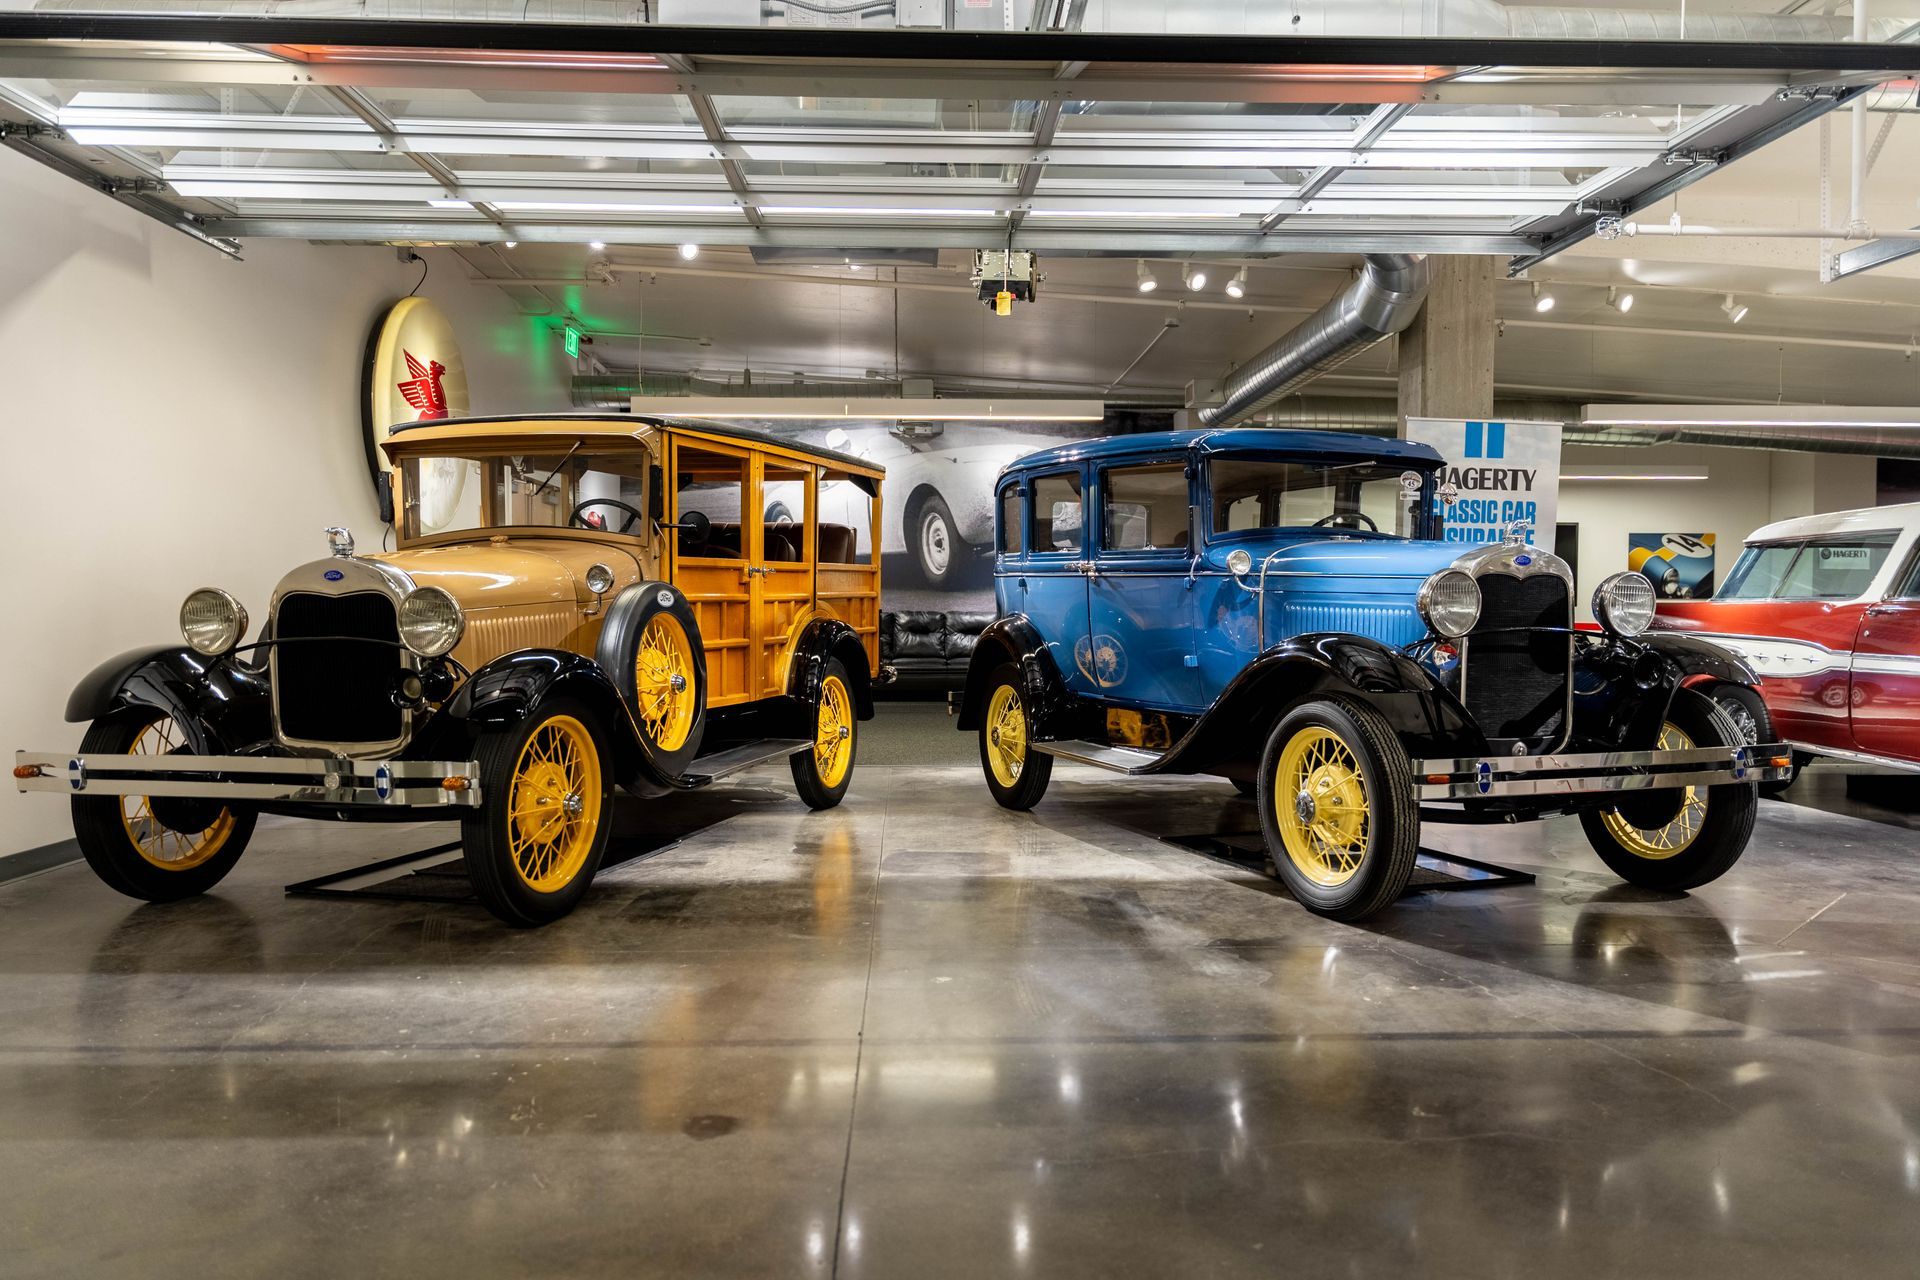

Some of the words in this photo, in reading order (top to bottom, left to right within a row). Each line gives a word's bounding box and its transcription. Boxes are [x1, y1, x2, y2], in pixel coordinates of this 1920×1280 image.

[1502, 500, 1536, 525] CAR
[1666, 535, 1706, 553] 14
[1833, 550, 1867, 558] HAGERTY
